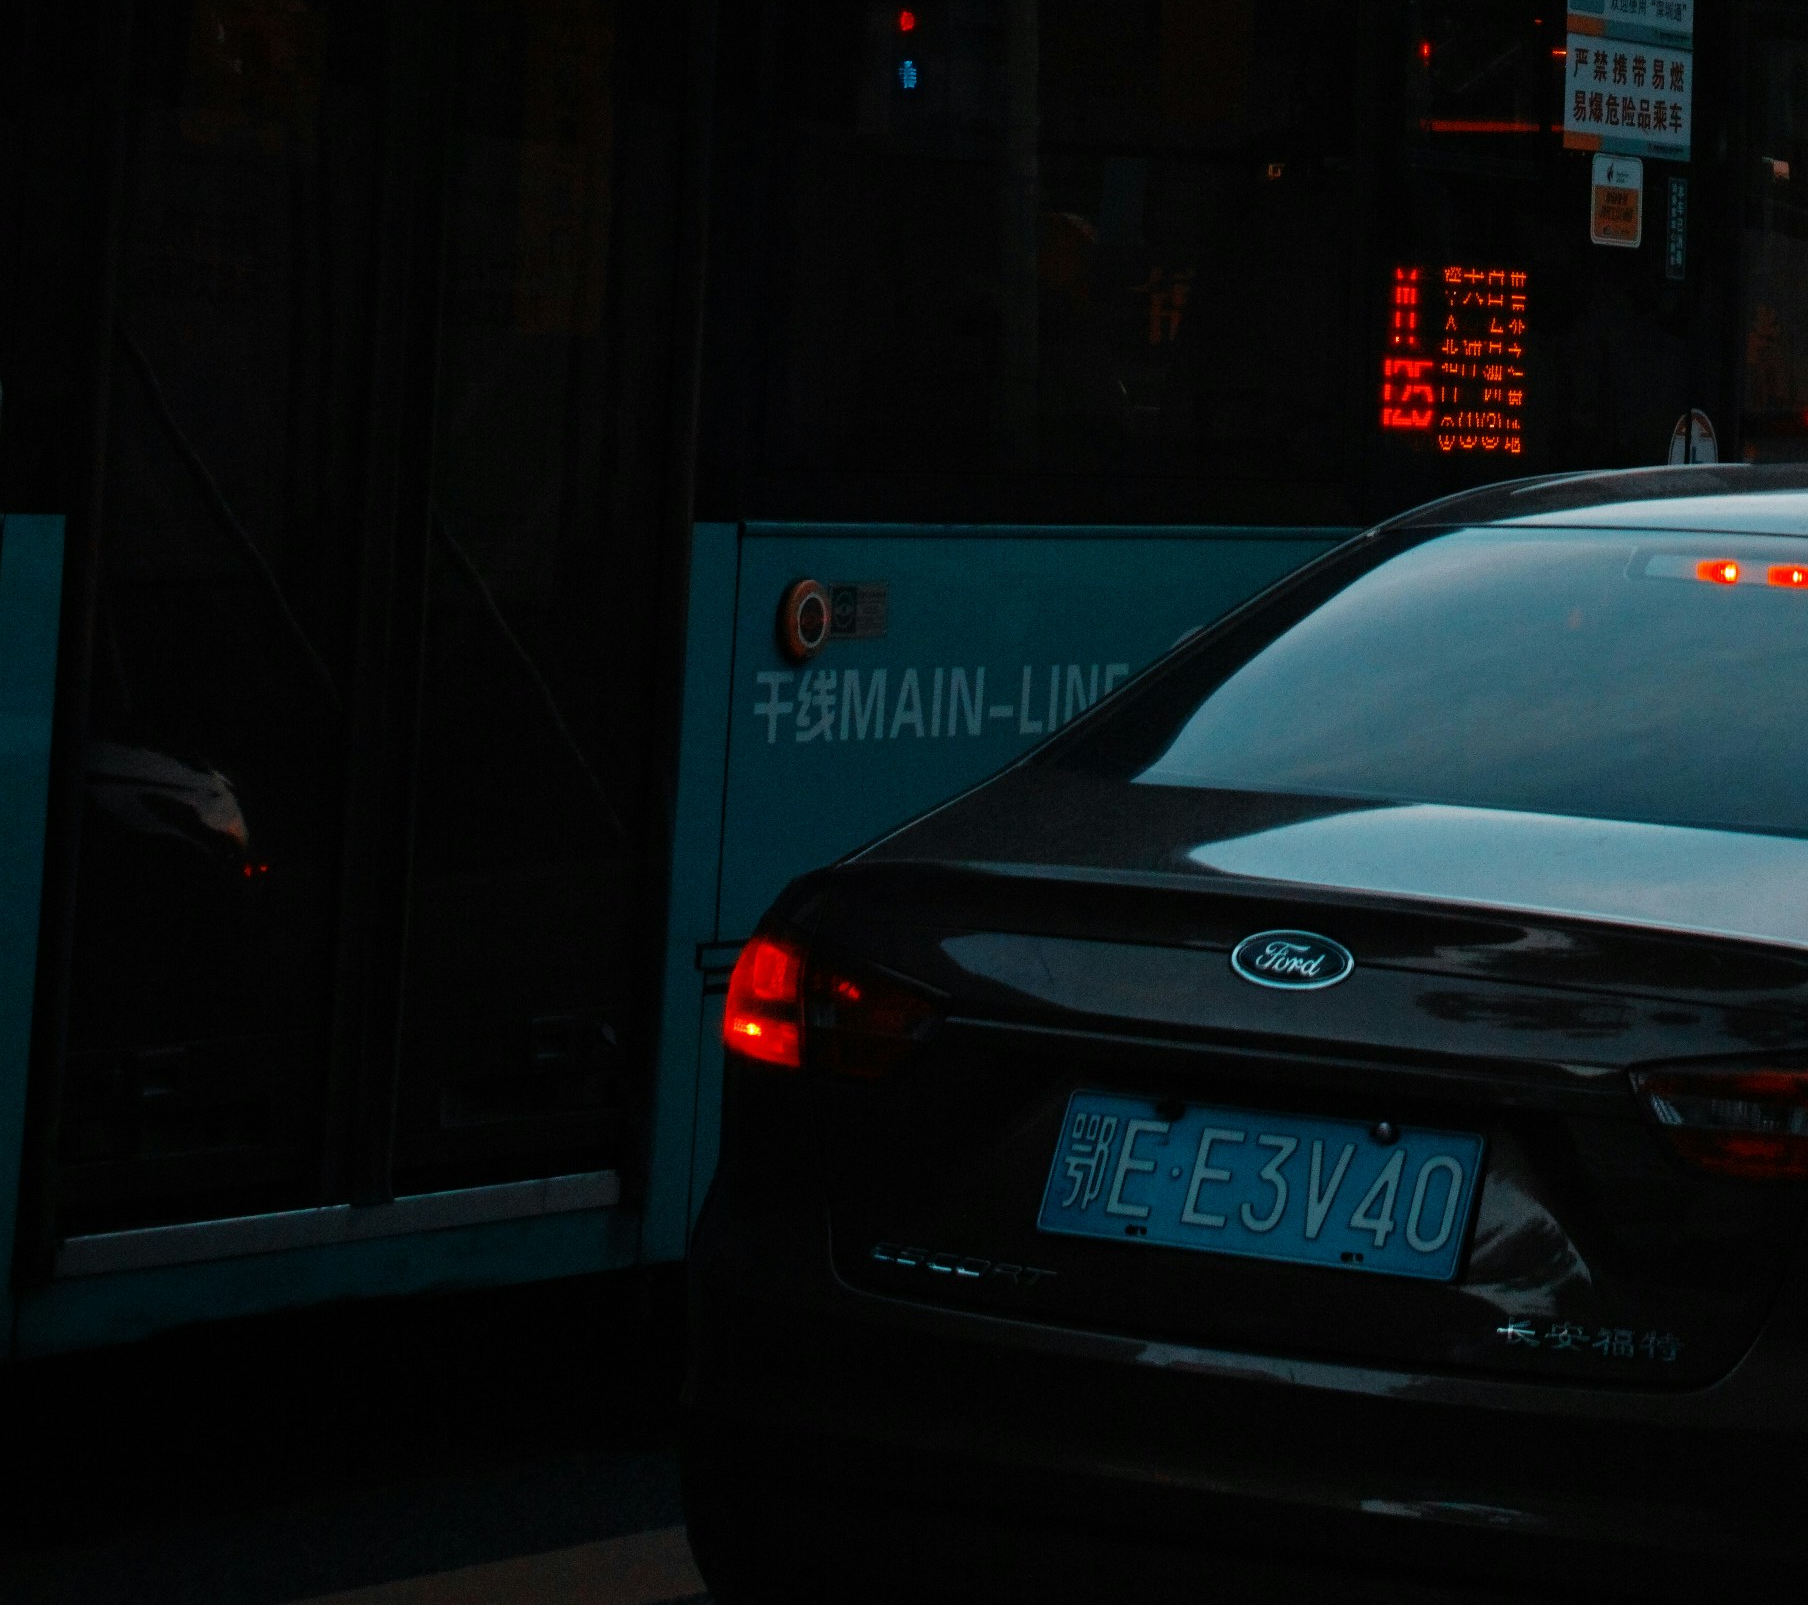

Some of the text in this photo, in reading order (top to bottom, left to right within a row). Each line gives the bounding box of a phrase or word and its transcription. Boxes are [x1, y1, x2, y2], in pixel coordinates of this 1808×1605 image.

[1573, 47, 1685, 93] 严禁携带易燃
[1573, 90, 1683, 133] 易爆危险品乘车
[1255, 940, 1326, 977] Ford
[1496, 1316, 1684, 1366] 长安福特
